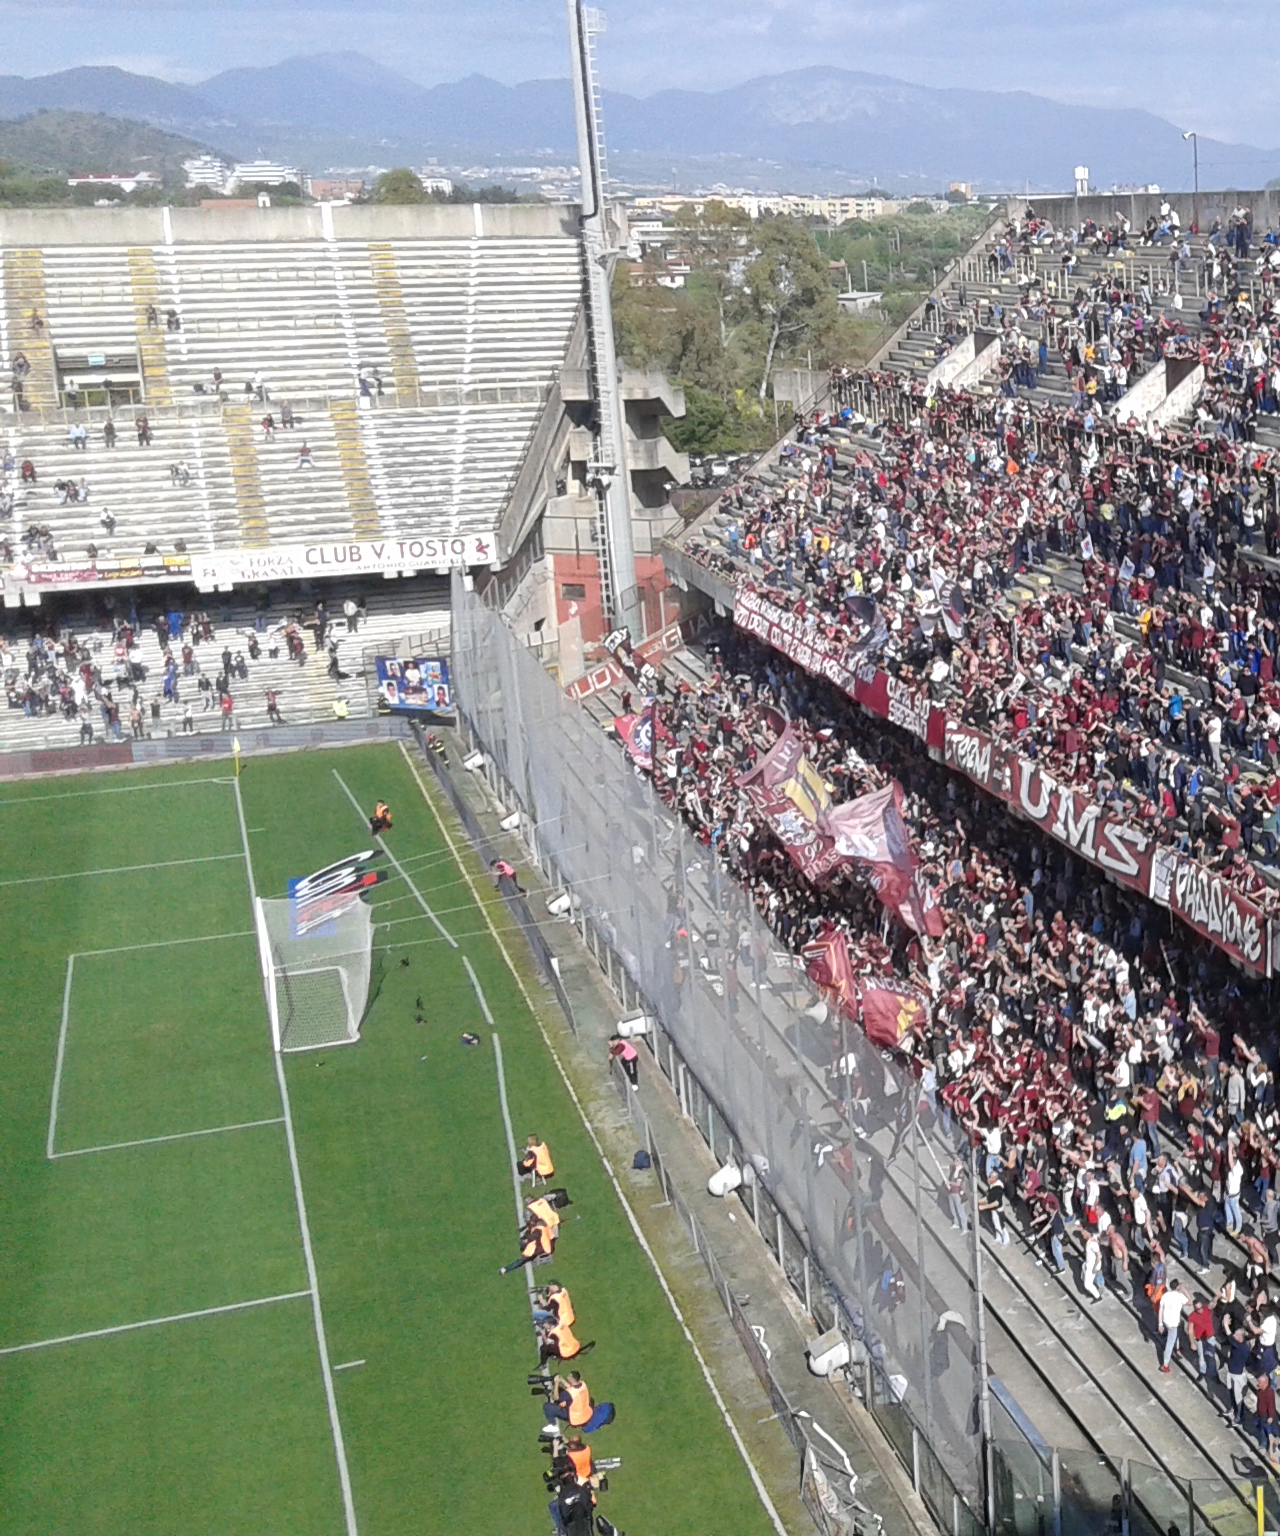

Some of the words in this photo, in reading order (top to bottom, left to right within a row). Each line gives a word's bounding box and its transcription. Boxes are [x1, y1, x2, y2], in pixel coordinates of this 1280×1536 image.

[306, 545, 362, 565] CLUB
[371, 543, 391, 560] V.
[396, 538, 466, 560] TOSTO
[249, 556, 294, 568] FORZA
[241, 566, 305, 579] GRANATA
